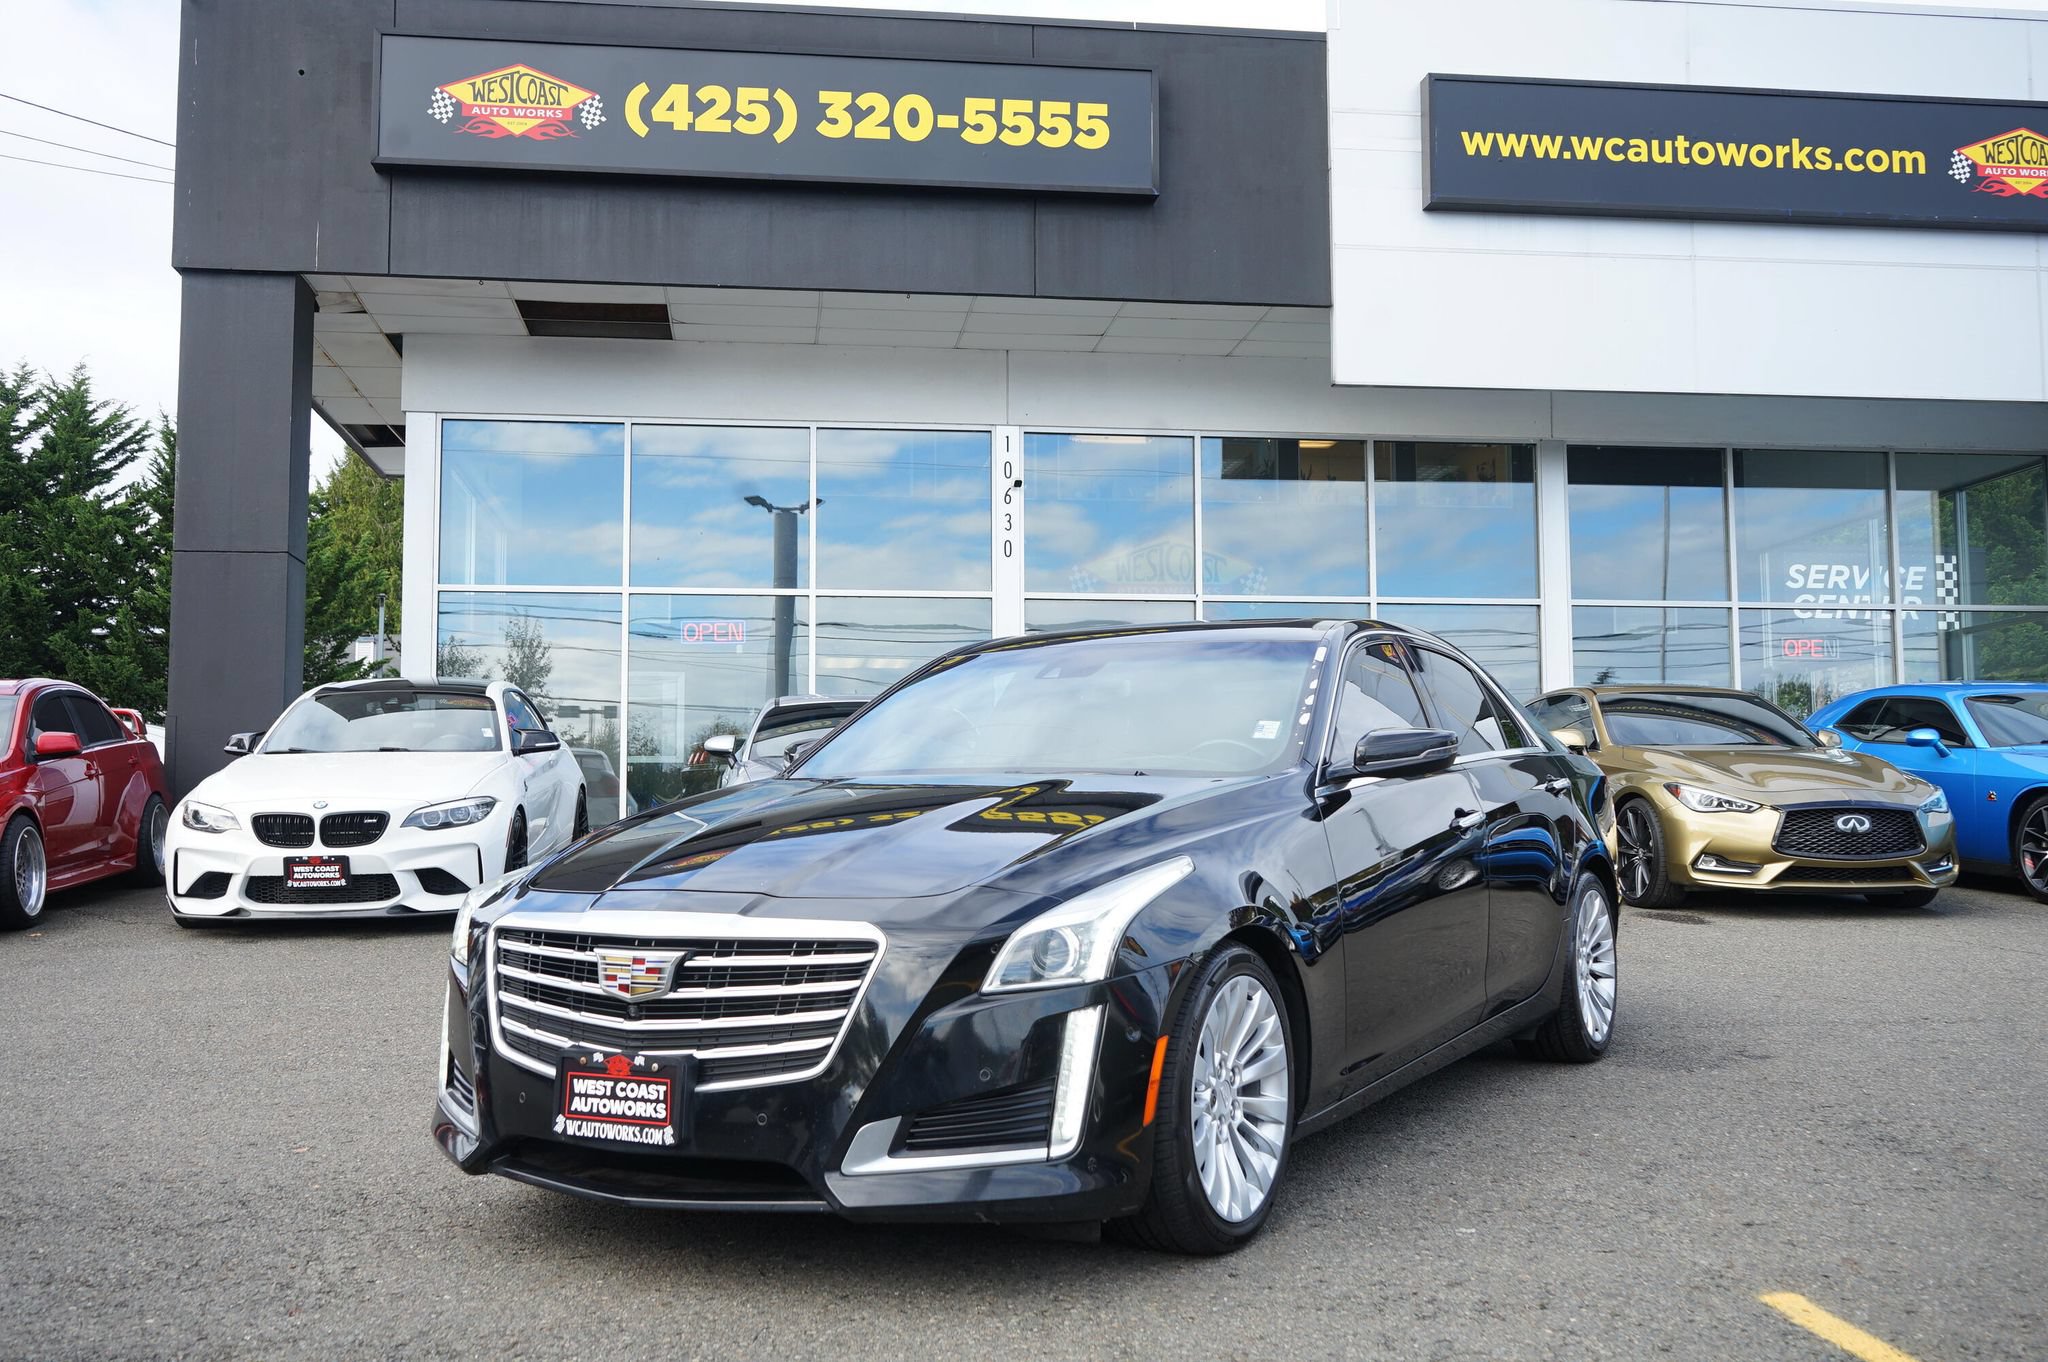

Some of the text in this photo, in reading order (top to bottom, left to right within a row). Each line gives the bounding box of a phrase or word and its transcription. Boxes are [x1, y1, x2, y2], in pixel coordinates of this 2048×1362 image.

[471, 106, 563, 118] AUTO WORKS
[624, 81, 1110, 150] (425) 320-5555
[1460, 130, 1927, 175] www.wcautoworks.com
[1985, 167, 2017, 175] AUTO
[1785, 563, 1927, 591] SERVCE
[683, 623, 743, 641] OPEN
[1783, 639, 1836, 657] OPEN
[573, 1078, 667, 1101] WEST COAST
[570, 1096, 667, 1119] AUTOWORKS
[565, 1119, 664, 1145] WCAUTOWORKS.COM
